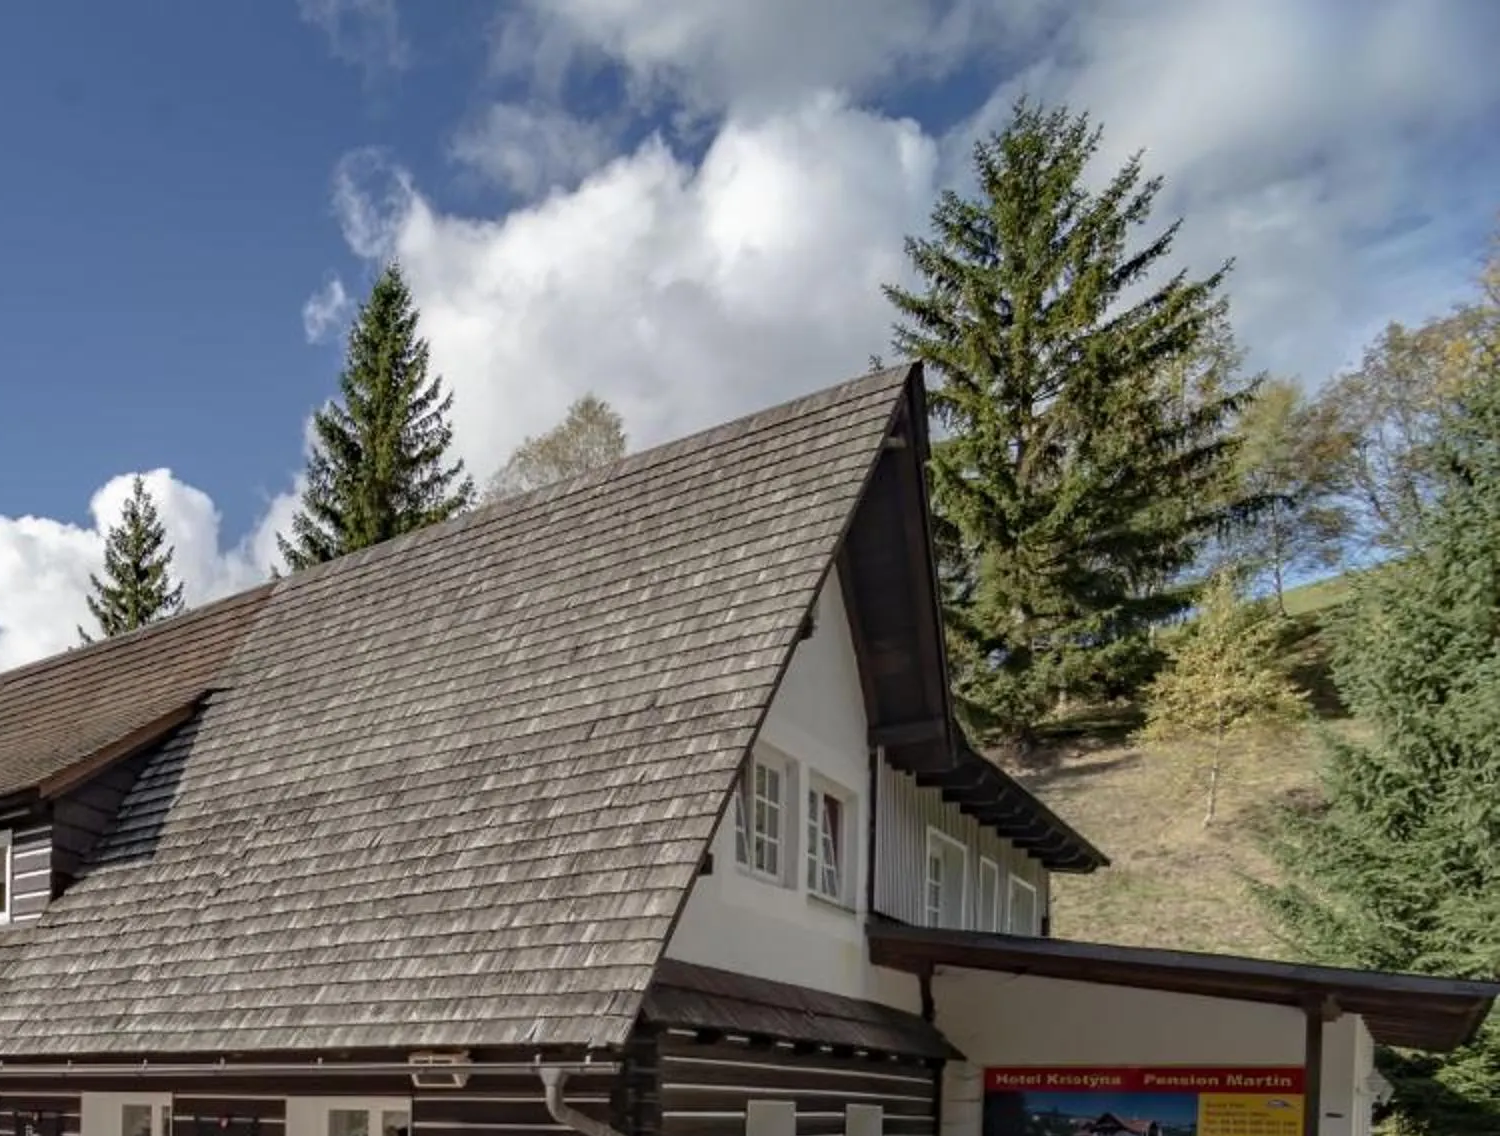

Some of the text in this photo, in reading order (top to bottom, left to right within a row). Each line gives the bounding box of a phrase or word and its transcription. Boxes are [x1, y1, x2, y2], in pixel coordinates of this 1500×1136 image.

[995, 1072, 1042, 1086] Hotel
[1143, 1072, 1220, 1086] Pension
[1225, 1073, 1293, 1087] Martin
